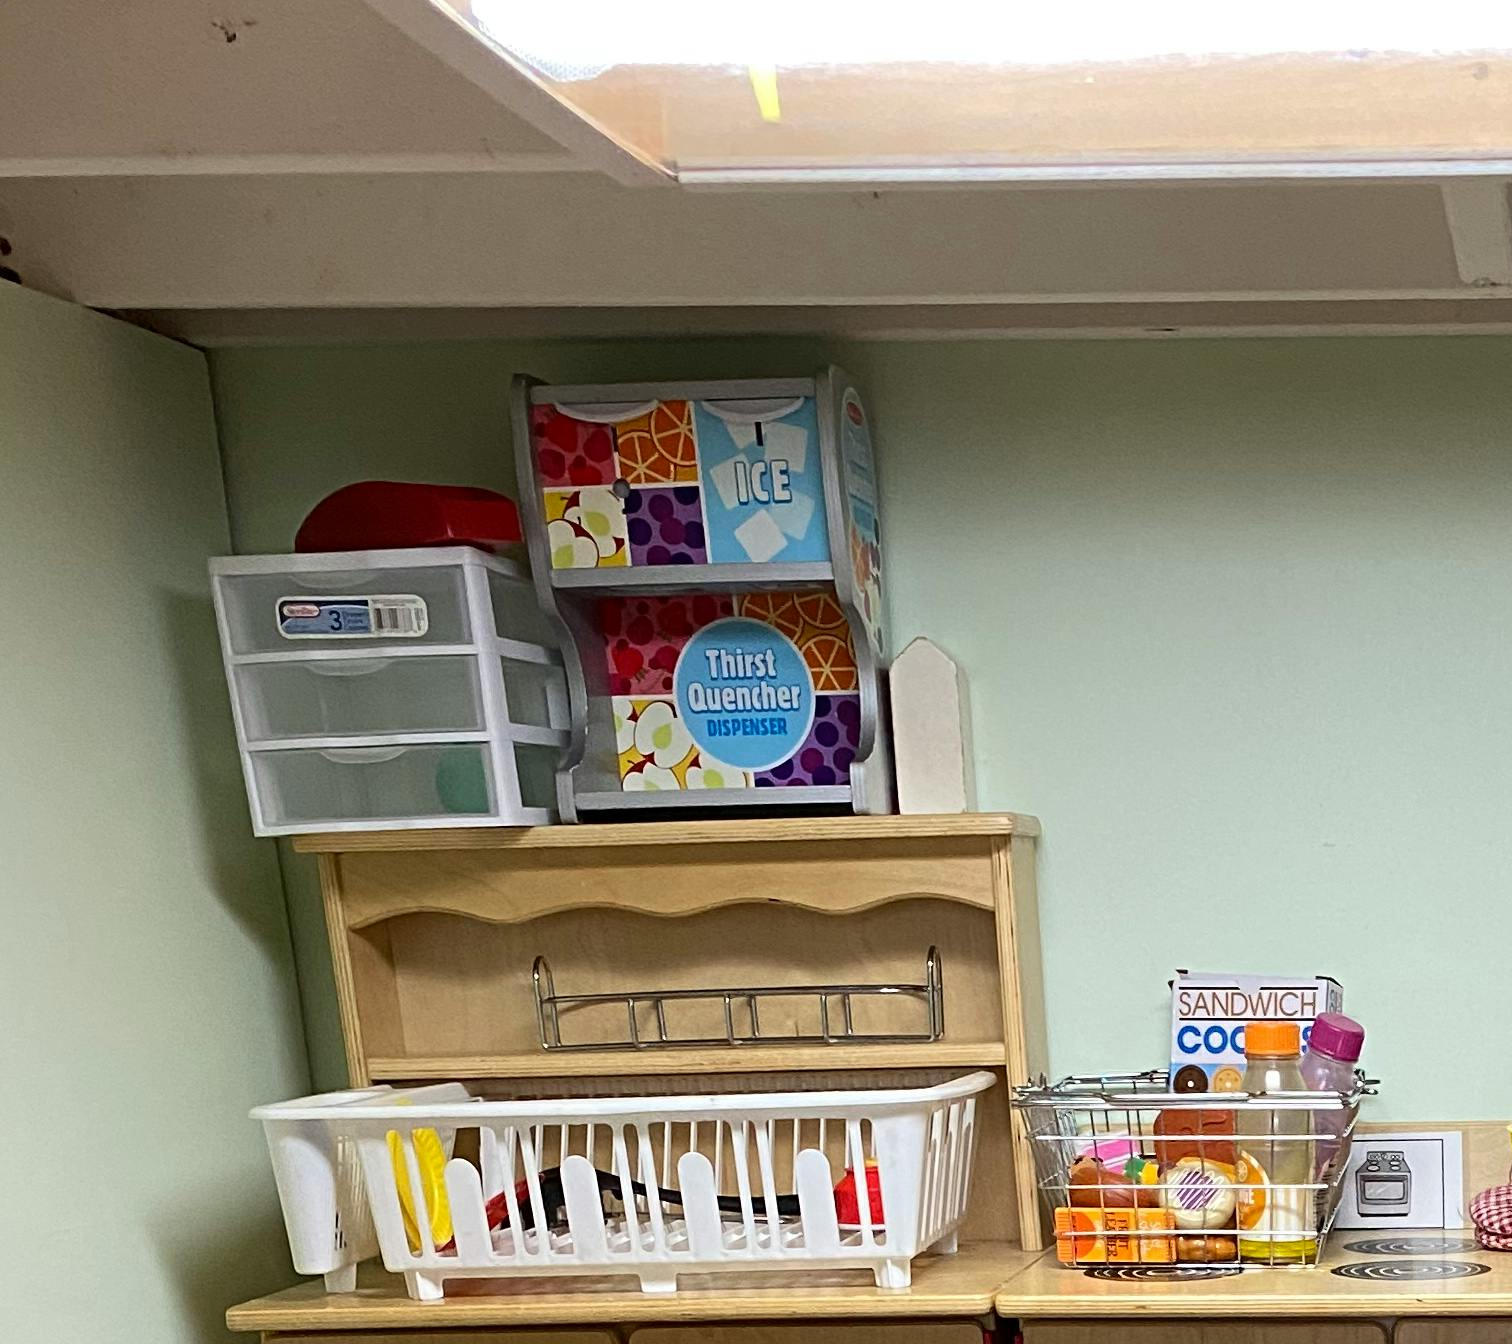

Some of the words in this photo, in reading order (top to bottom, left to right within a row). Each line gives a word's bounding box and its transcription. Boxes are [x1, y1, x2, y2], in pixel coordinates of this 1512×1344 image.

[735, 459, 793, 505] ICE
[328, 610, 343, 631] 3
[705, 648, 778, 680] Thirst
[687, 679, 801, 714] Quencher
[706, 717, 788, 737] DISPENSER
[1178, 991, 1317, 1017] SANDWICH
